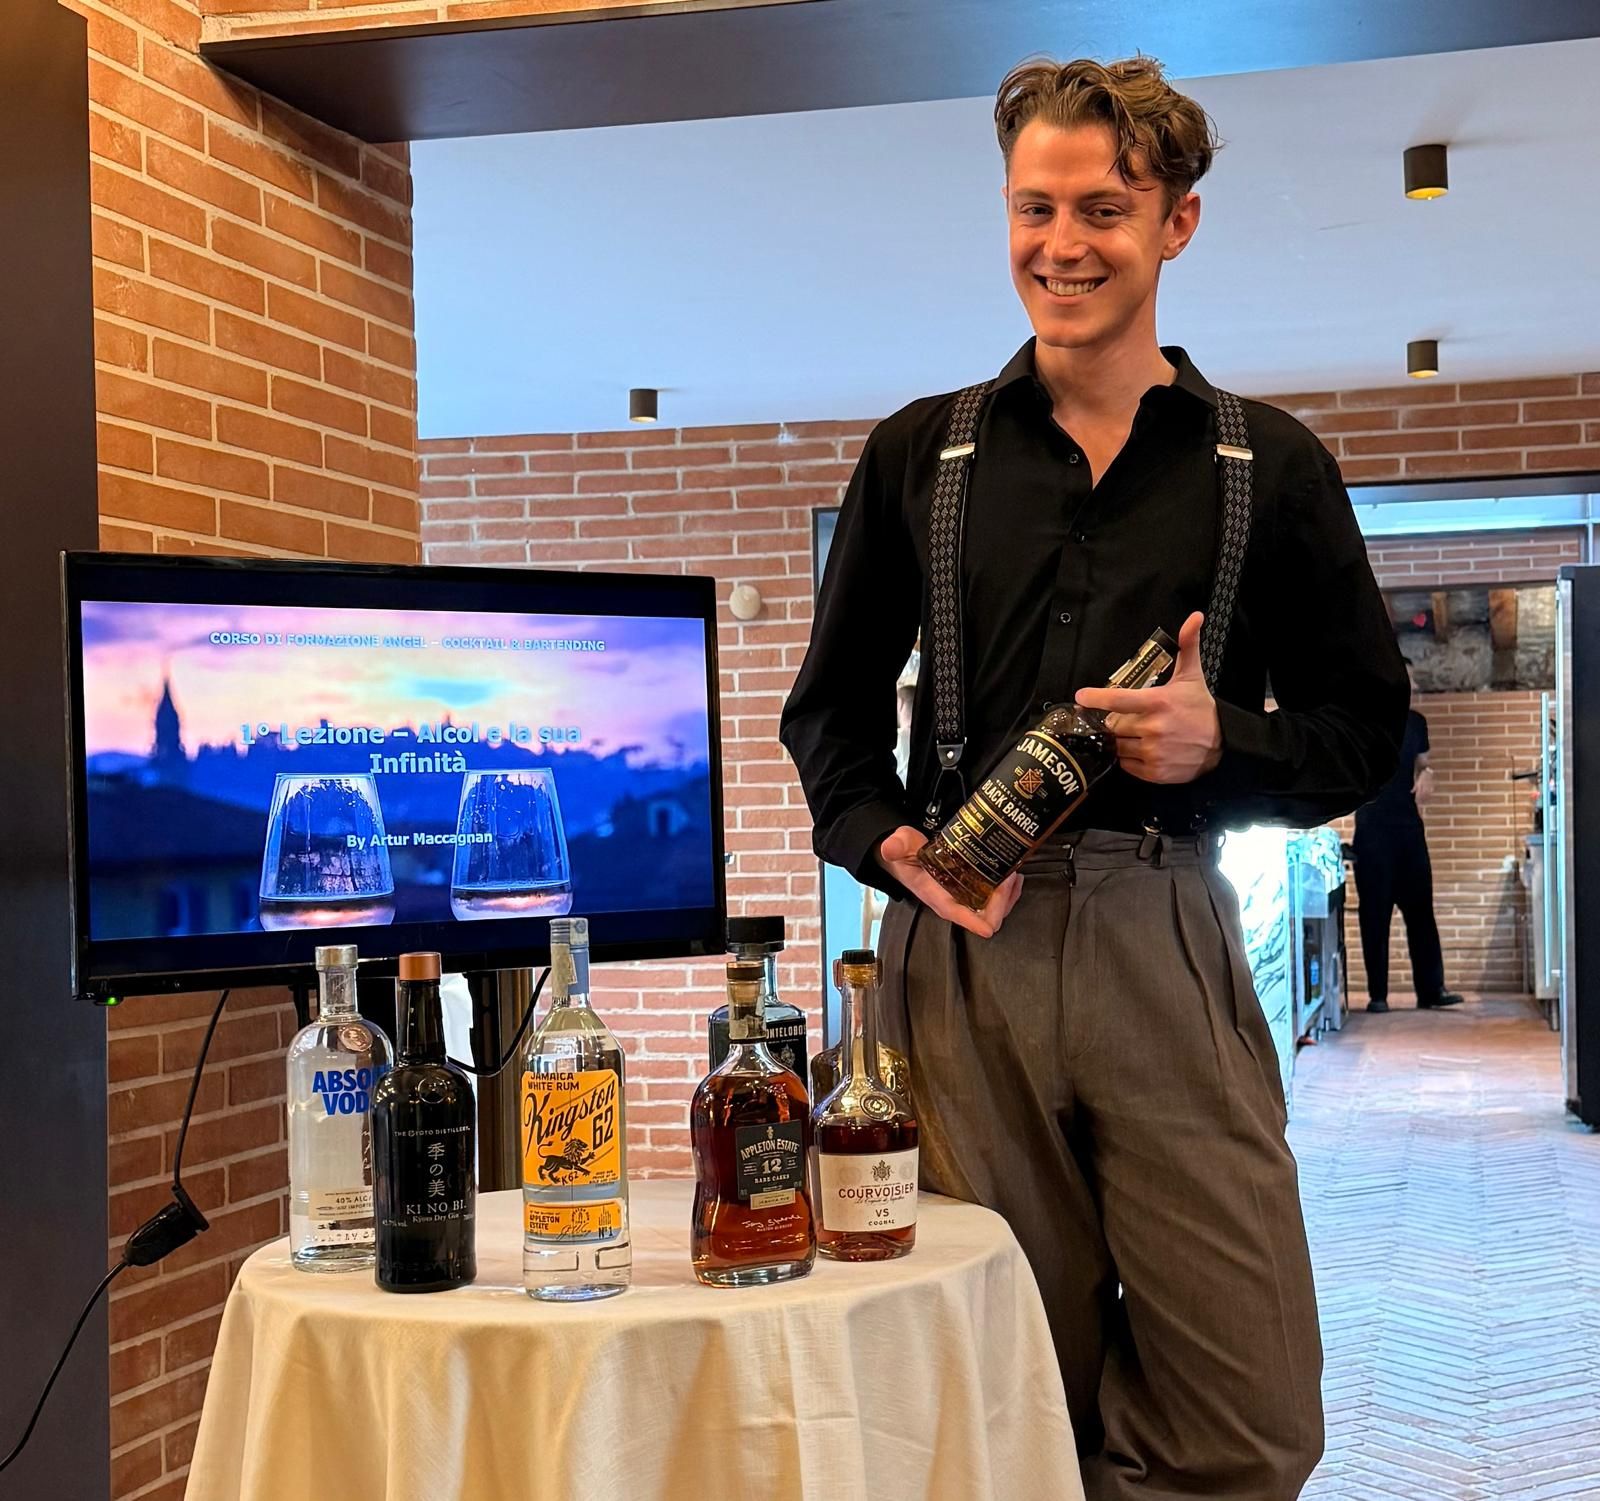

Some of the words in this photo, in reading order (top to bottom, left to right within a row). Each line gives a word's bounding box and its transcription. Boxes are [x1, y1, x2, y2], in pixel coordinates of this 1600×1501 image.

[209, 632, 261, 645] CORSO
[264, 633, 282, 646] DI
[286, 633, 380, 648] FORMAZIONE
[383, 635, 428, 649] ANGEL
[442, 636, 508, 650] COCKTAIL
[511, 639, 521, 650] &
[524, 638, 606, 651] BARTENDING
[280, 723, 385, 745] Lezione
[417, 722, 479, 744] Alcol
[486, 726, 502, 743] e
[509, 721, 536, 743] la
[539, 726, 582, 743] sua
[370, 750, 467, 774] Infinità
[1016, 737, 1080, 796] JAMESON
[981, 779, 1009, 809] BLACK
[1002, 801, 1040, 837] BARREL
[347, 835, 365, 849] By
[370, 834, 410, 847] Artur
[413, 832, 493, 848] Maccagnan
[765, 1024, 807, 1040] ONTELOBOS
[312, 1067, 375, 1093] ABSO
[528, 1082, 553, 1091] WHITE
[556, 1081, 580, 1091] RUM
[530, 1072, 574, 1081] JAMAICA
[322, 1091, 370, 1116] VOD
[523, 1079, 615, 1158] Kingston
[592, 1104, 614, 1151] 62
[740, 1139, 776, 1161] APPLETON
[776, 1138, 800, 1154] ESTATE
[427, 1142, 446, 1198] 季の美
[761, 1158, 783, 1175] 12
[838, 1182, 915, 1199] COURVOISIER
[406, 1204, 421, 1215] KI
[427, 1202, 448, 1214] NO
[875, 1208, 890, 1218] VS
